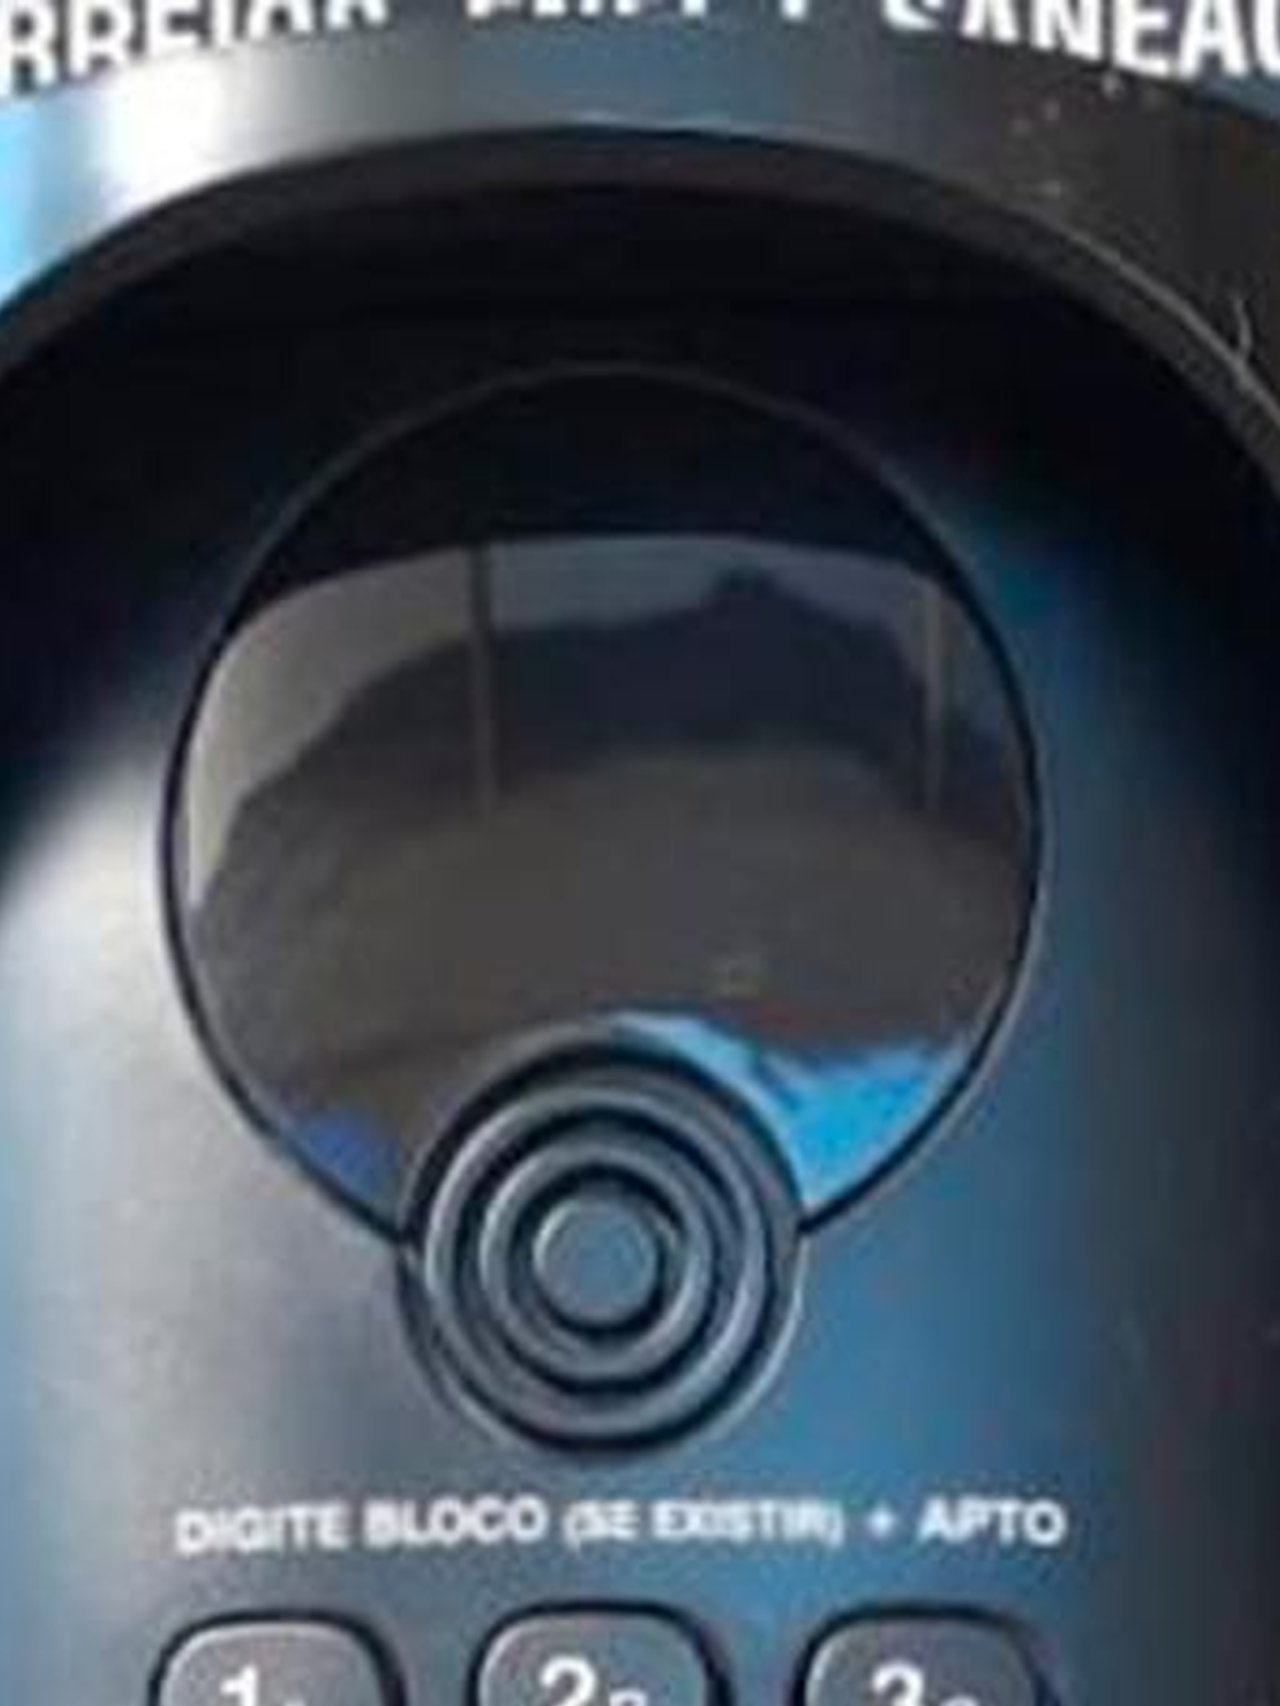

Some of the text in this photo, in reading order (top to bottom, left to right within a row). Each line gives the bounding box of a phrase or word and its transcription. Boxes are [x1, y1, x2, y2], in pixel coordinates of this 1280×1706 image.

[173, 1502, 350, 1556] DIGITE
[362, 1494, 551, 1549] BLOCO
[916, 1494, 1068, 1547] APTO
